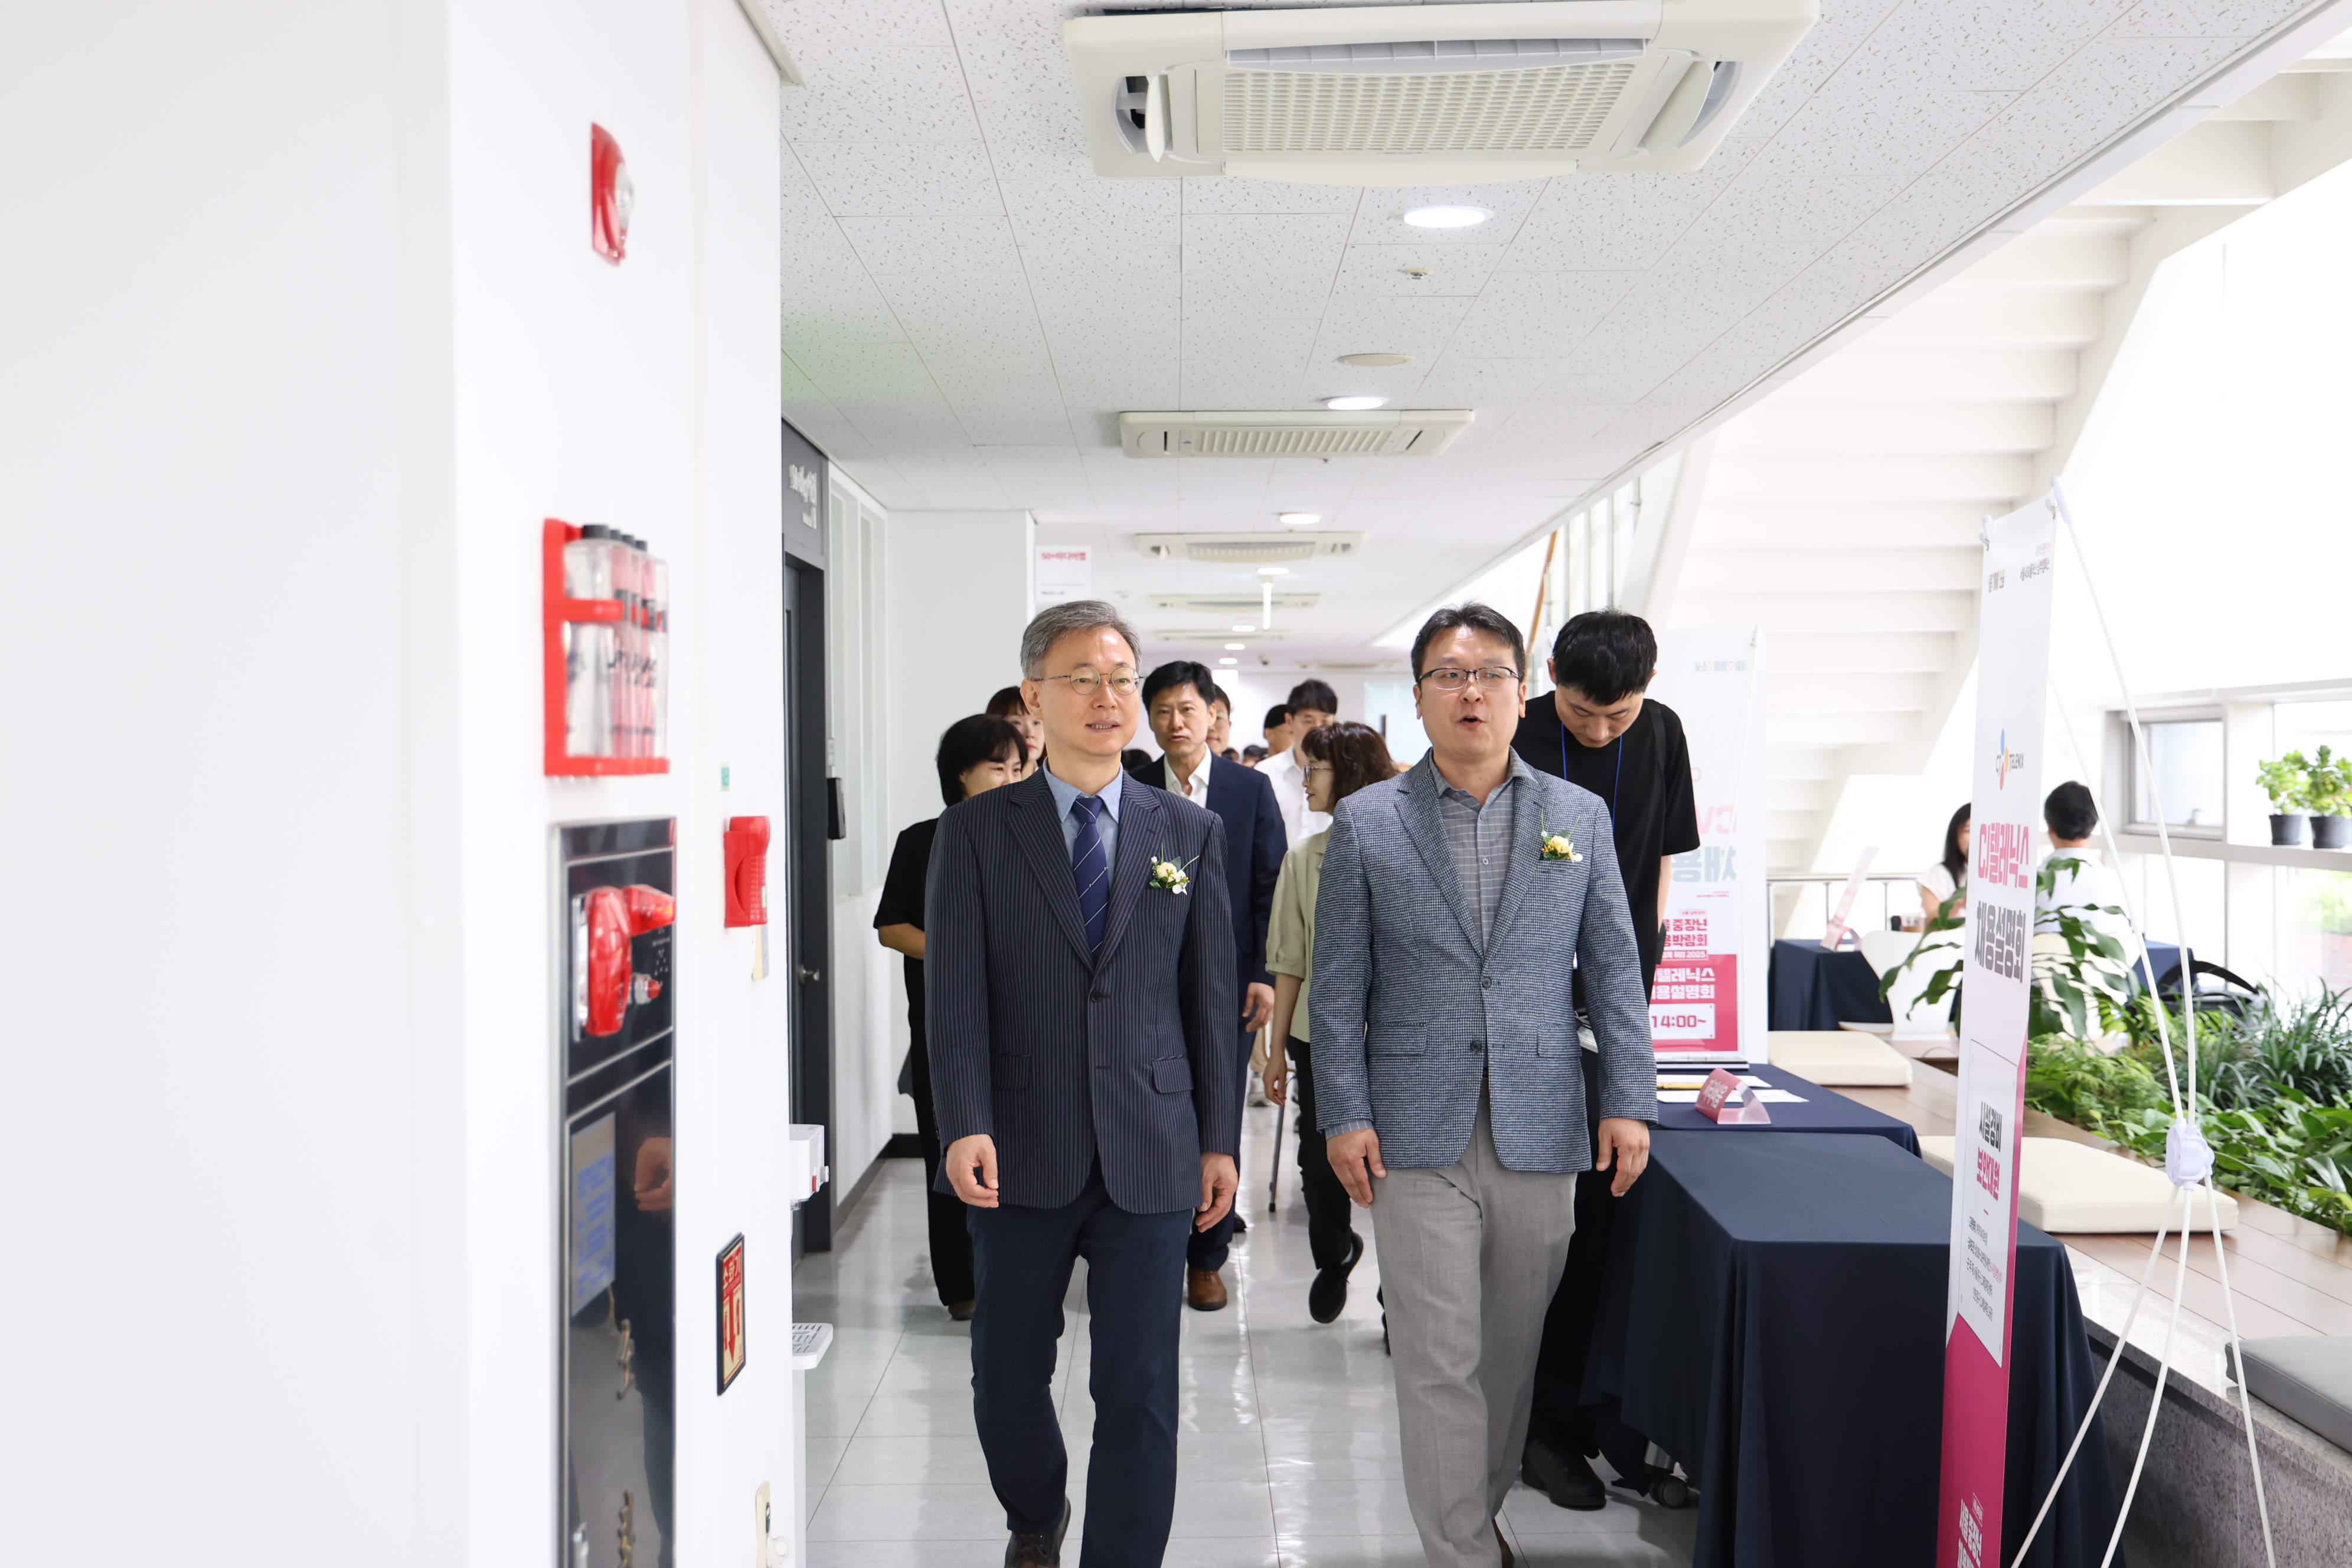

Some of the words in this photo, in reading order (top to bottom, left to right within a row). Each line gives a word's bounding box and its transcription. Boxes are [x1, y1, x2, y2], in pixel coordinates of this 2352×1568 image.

[2009, 753, 2024, 773] TELENIX
[1978, 822, 2030, 888] CJ텔레닉스
[1664, 933, 1707, 946] 용박람회
[1975, 900, 2026, 984] 채용설명회
[1654, 967, 1716, 982] 텔레닉스
[1651, 1015, 1707, 1028] 14:00~
[1979, 1101, 2003, 1152] 시설경비
[1977, 1147, 2000, 1201] 보안대원
